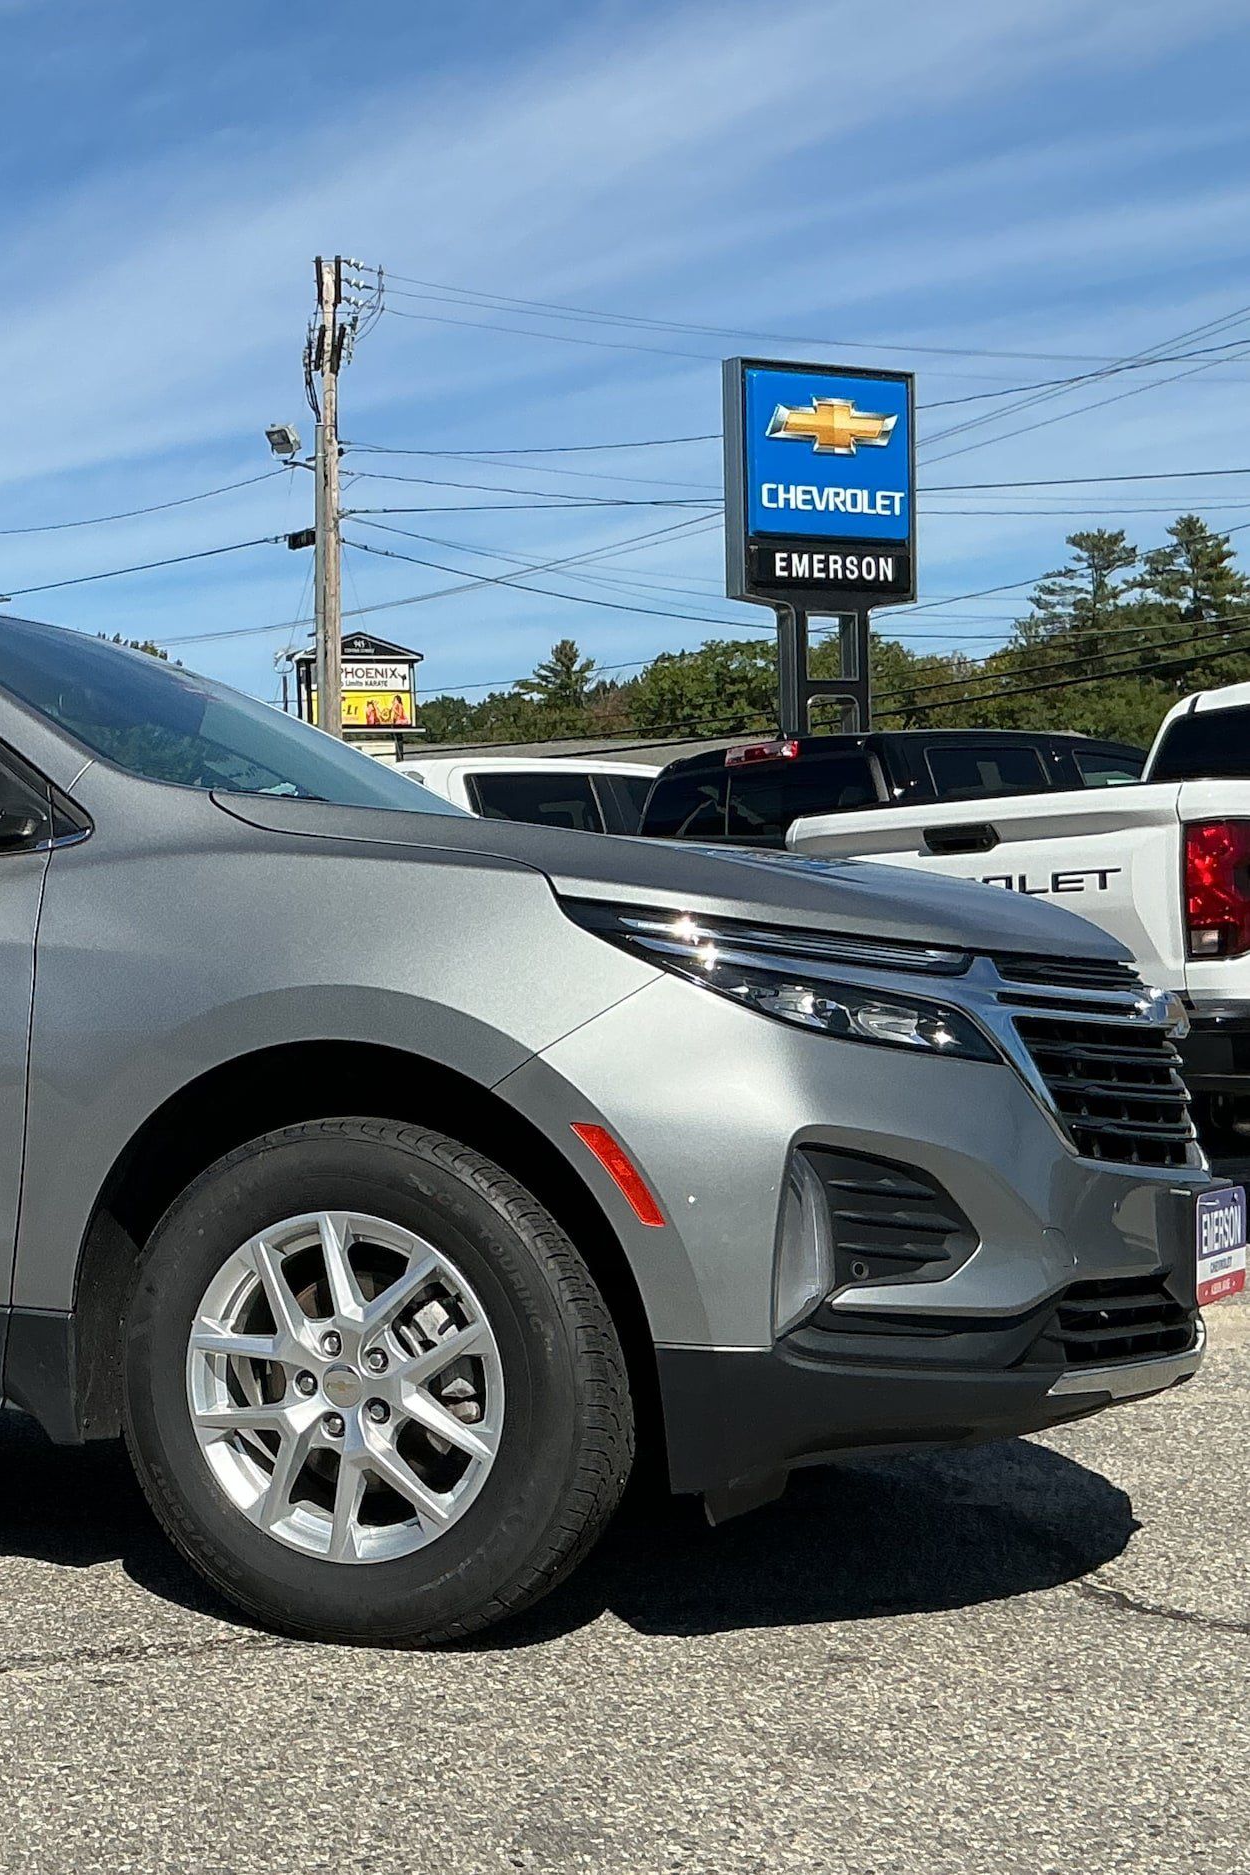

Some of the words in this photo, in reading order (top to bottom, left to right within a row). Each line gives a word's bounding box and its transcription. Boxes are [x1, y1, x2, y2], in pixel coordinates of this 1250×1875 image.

[761, 483, 905, 516] CHEVROLET
[774, 552, 894, 582] EMERSON
[967, 868, 1122, 895] OLET
[1202, 1205, 1242, 1255] EMERSON
